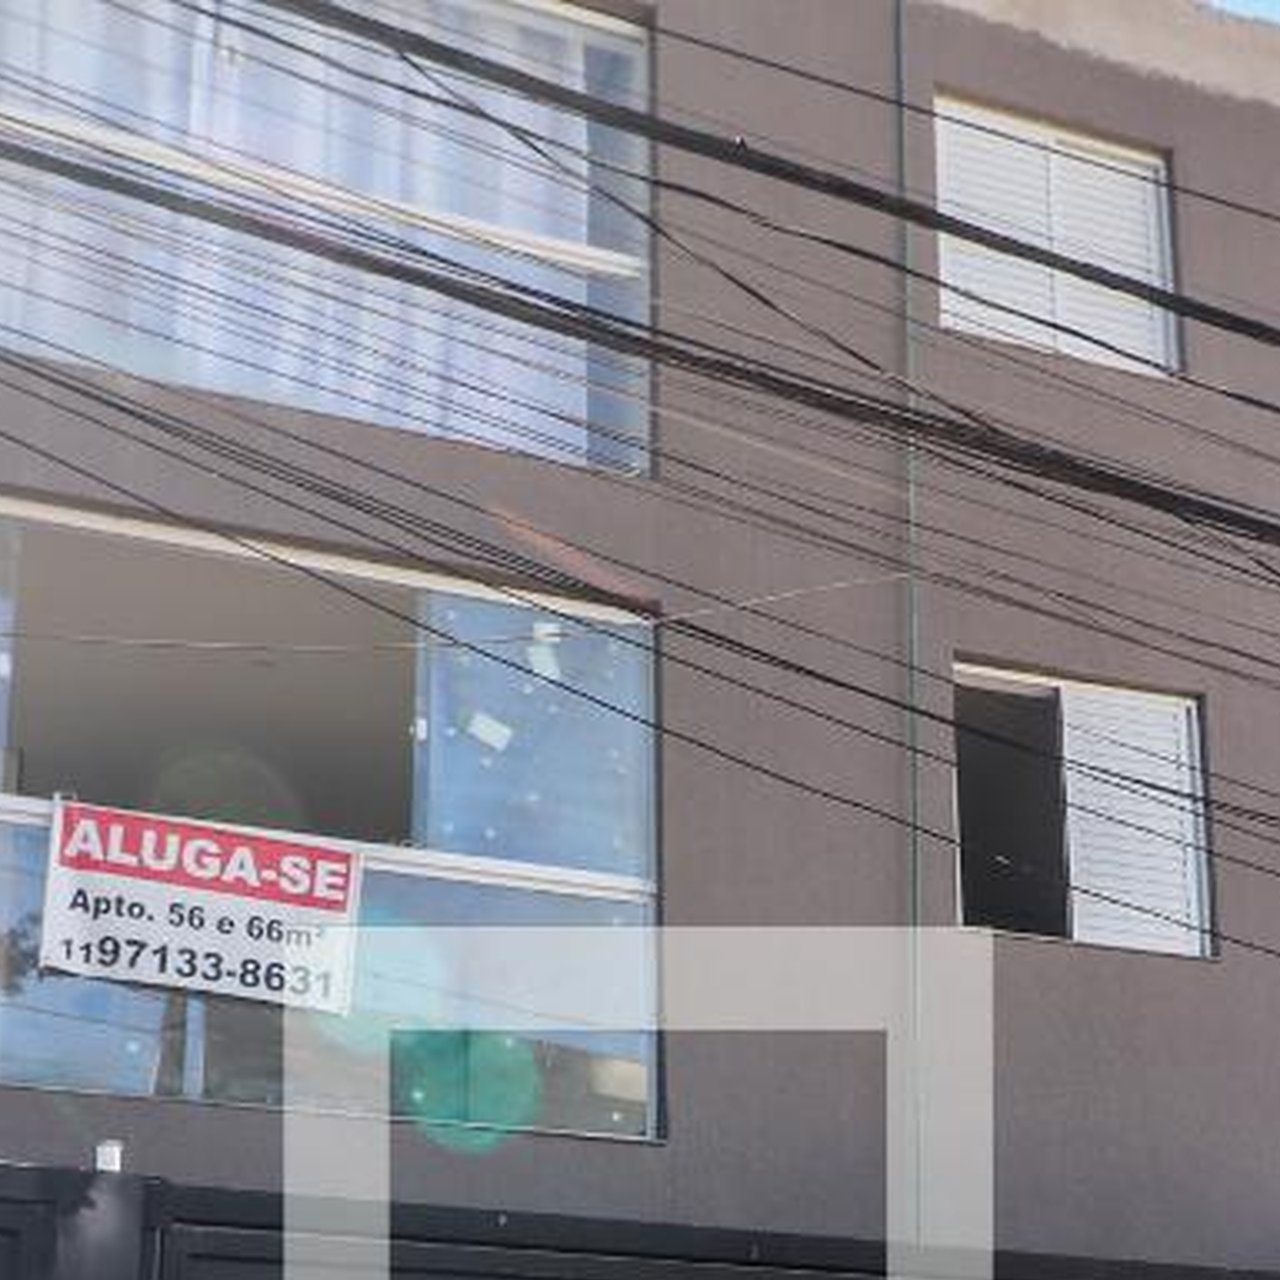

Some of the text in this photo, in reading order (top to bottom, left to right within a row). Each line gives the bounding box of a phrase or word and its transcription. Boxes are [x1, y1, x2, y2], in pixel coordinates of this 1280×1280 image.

[64, 818, 348, 901] ALUGA-SE
[69, 888, 155, 921] Apto.
[168, 903, 206, 930] 56
[216, 916, 235, 934] e
